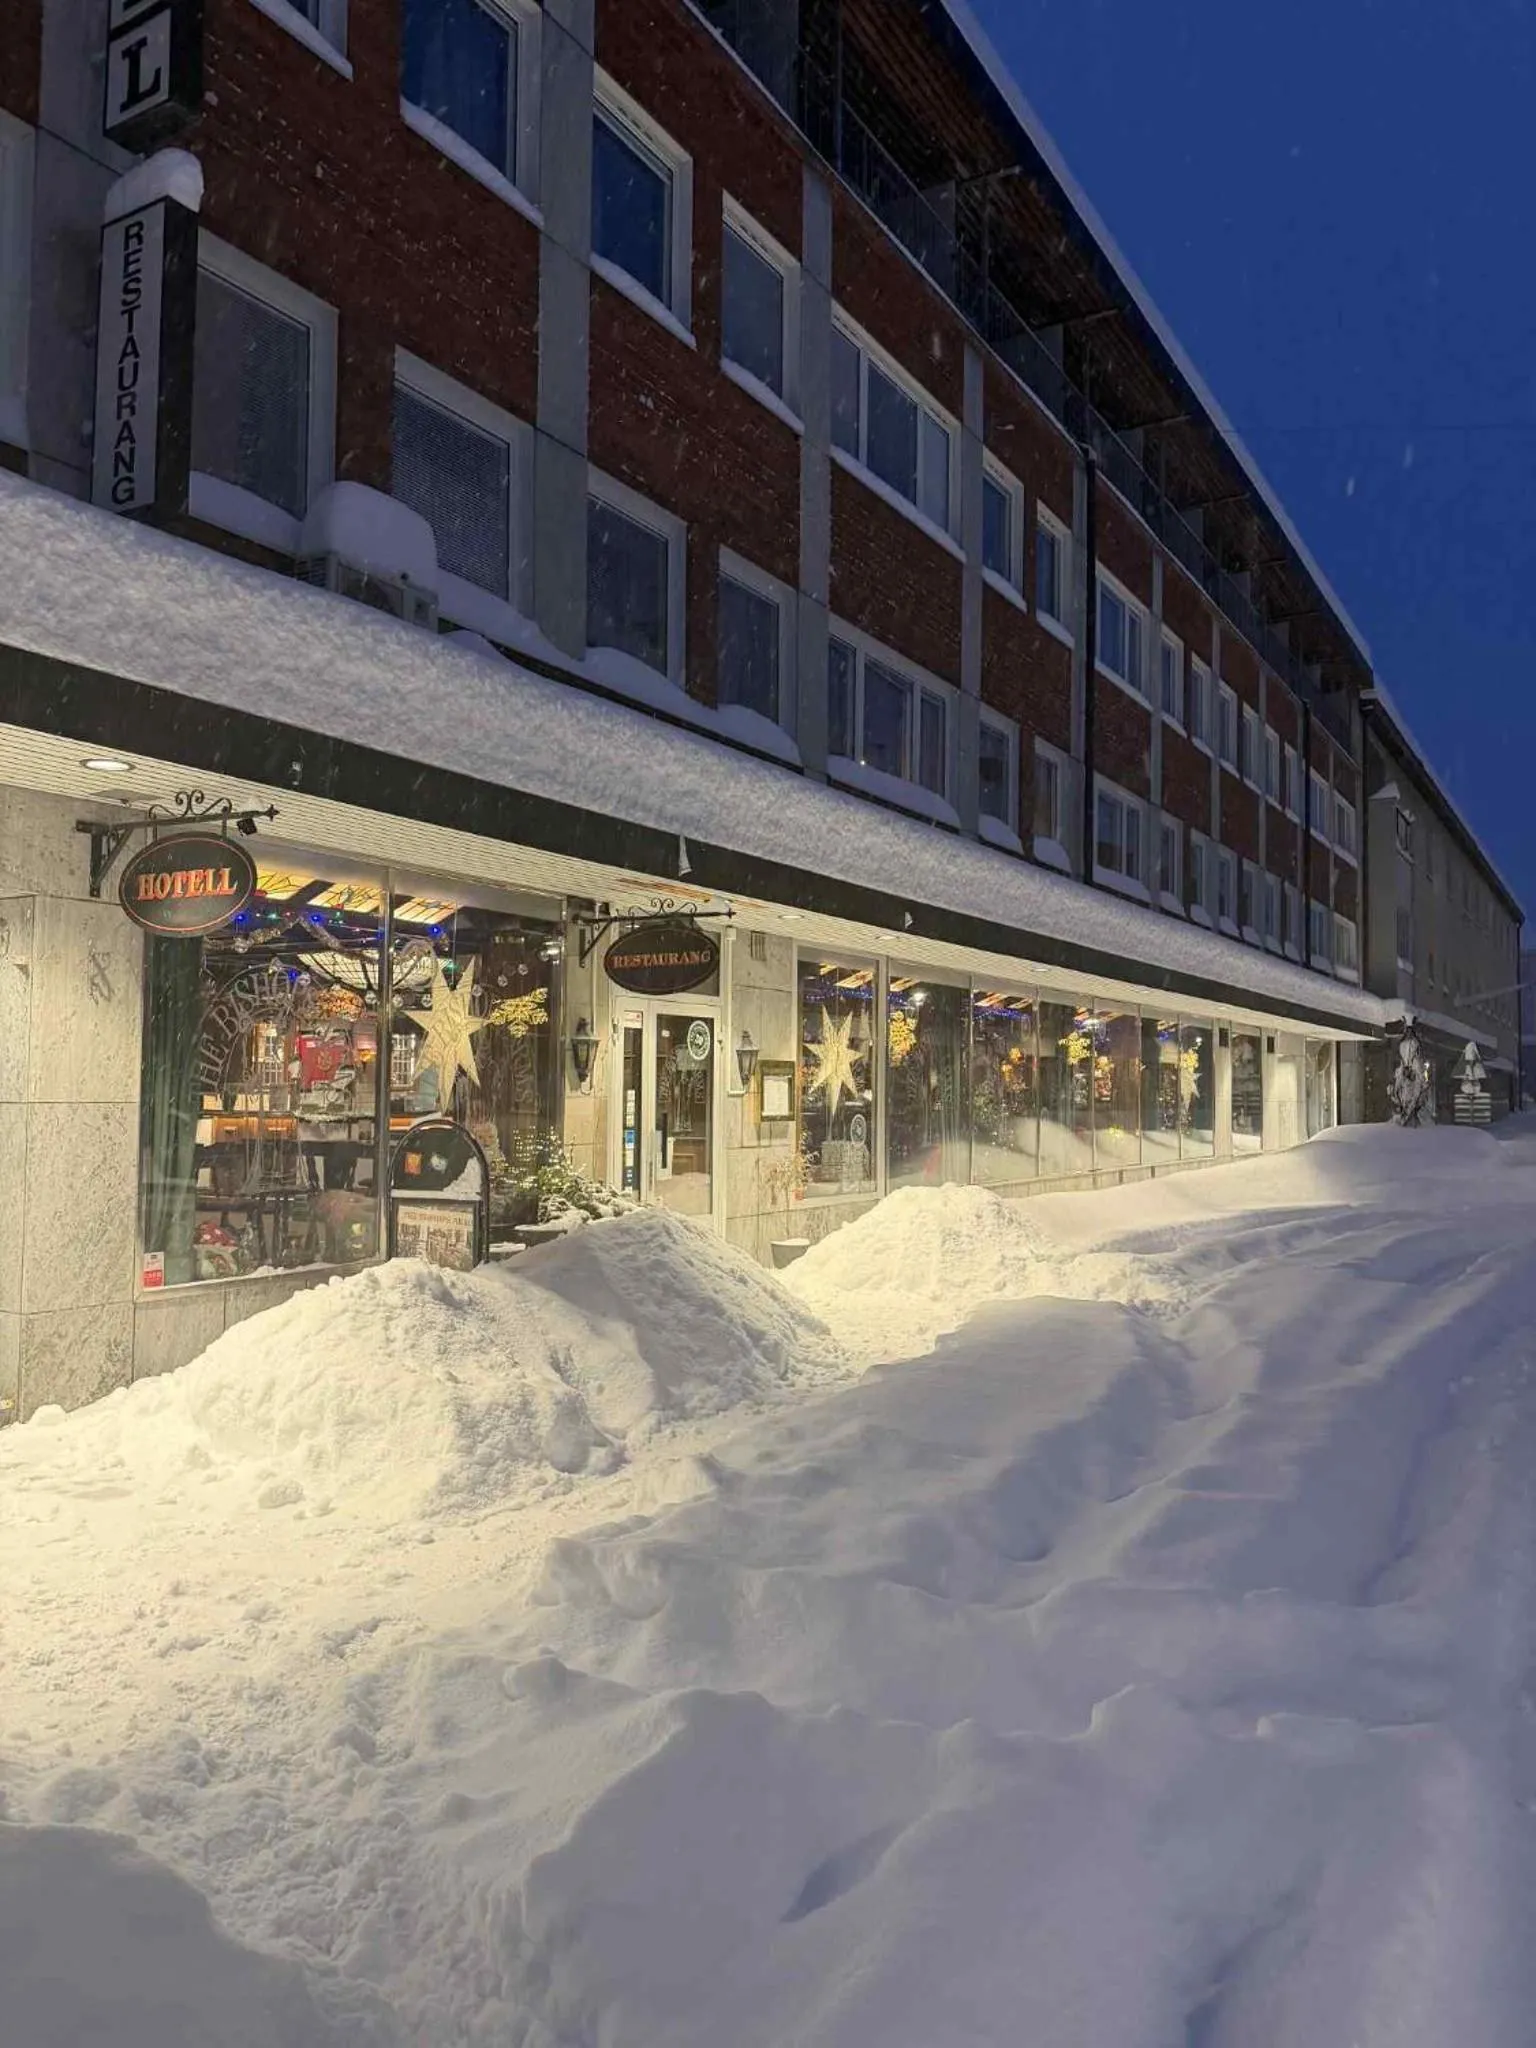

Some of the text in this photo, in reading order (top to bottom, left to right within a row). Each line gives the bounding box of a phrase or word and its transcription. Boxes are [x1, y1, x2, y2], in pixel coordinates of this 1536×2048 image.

[111, 222, 144, 505] RESTAURANG
[137, 867, 239, 900] HOTELL
[612, 950, 711, 969] RESTAURANG
